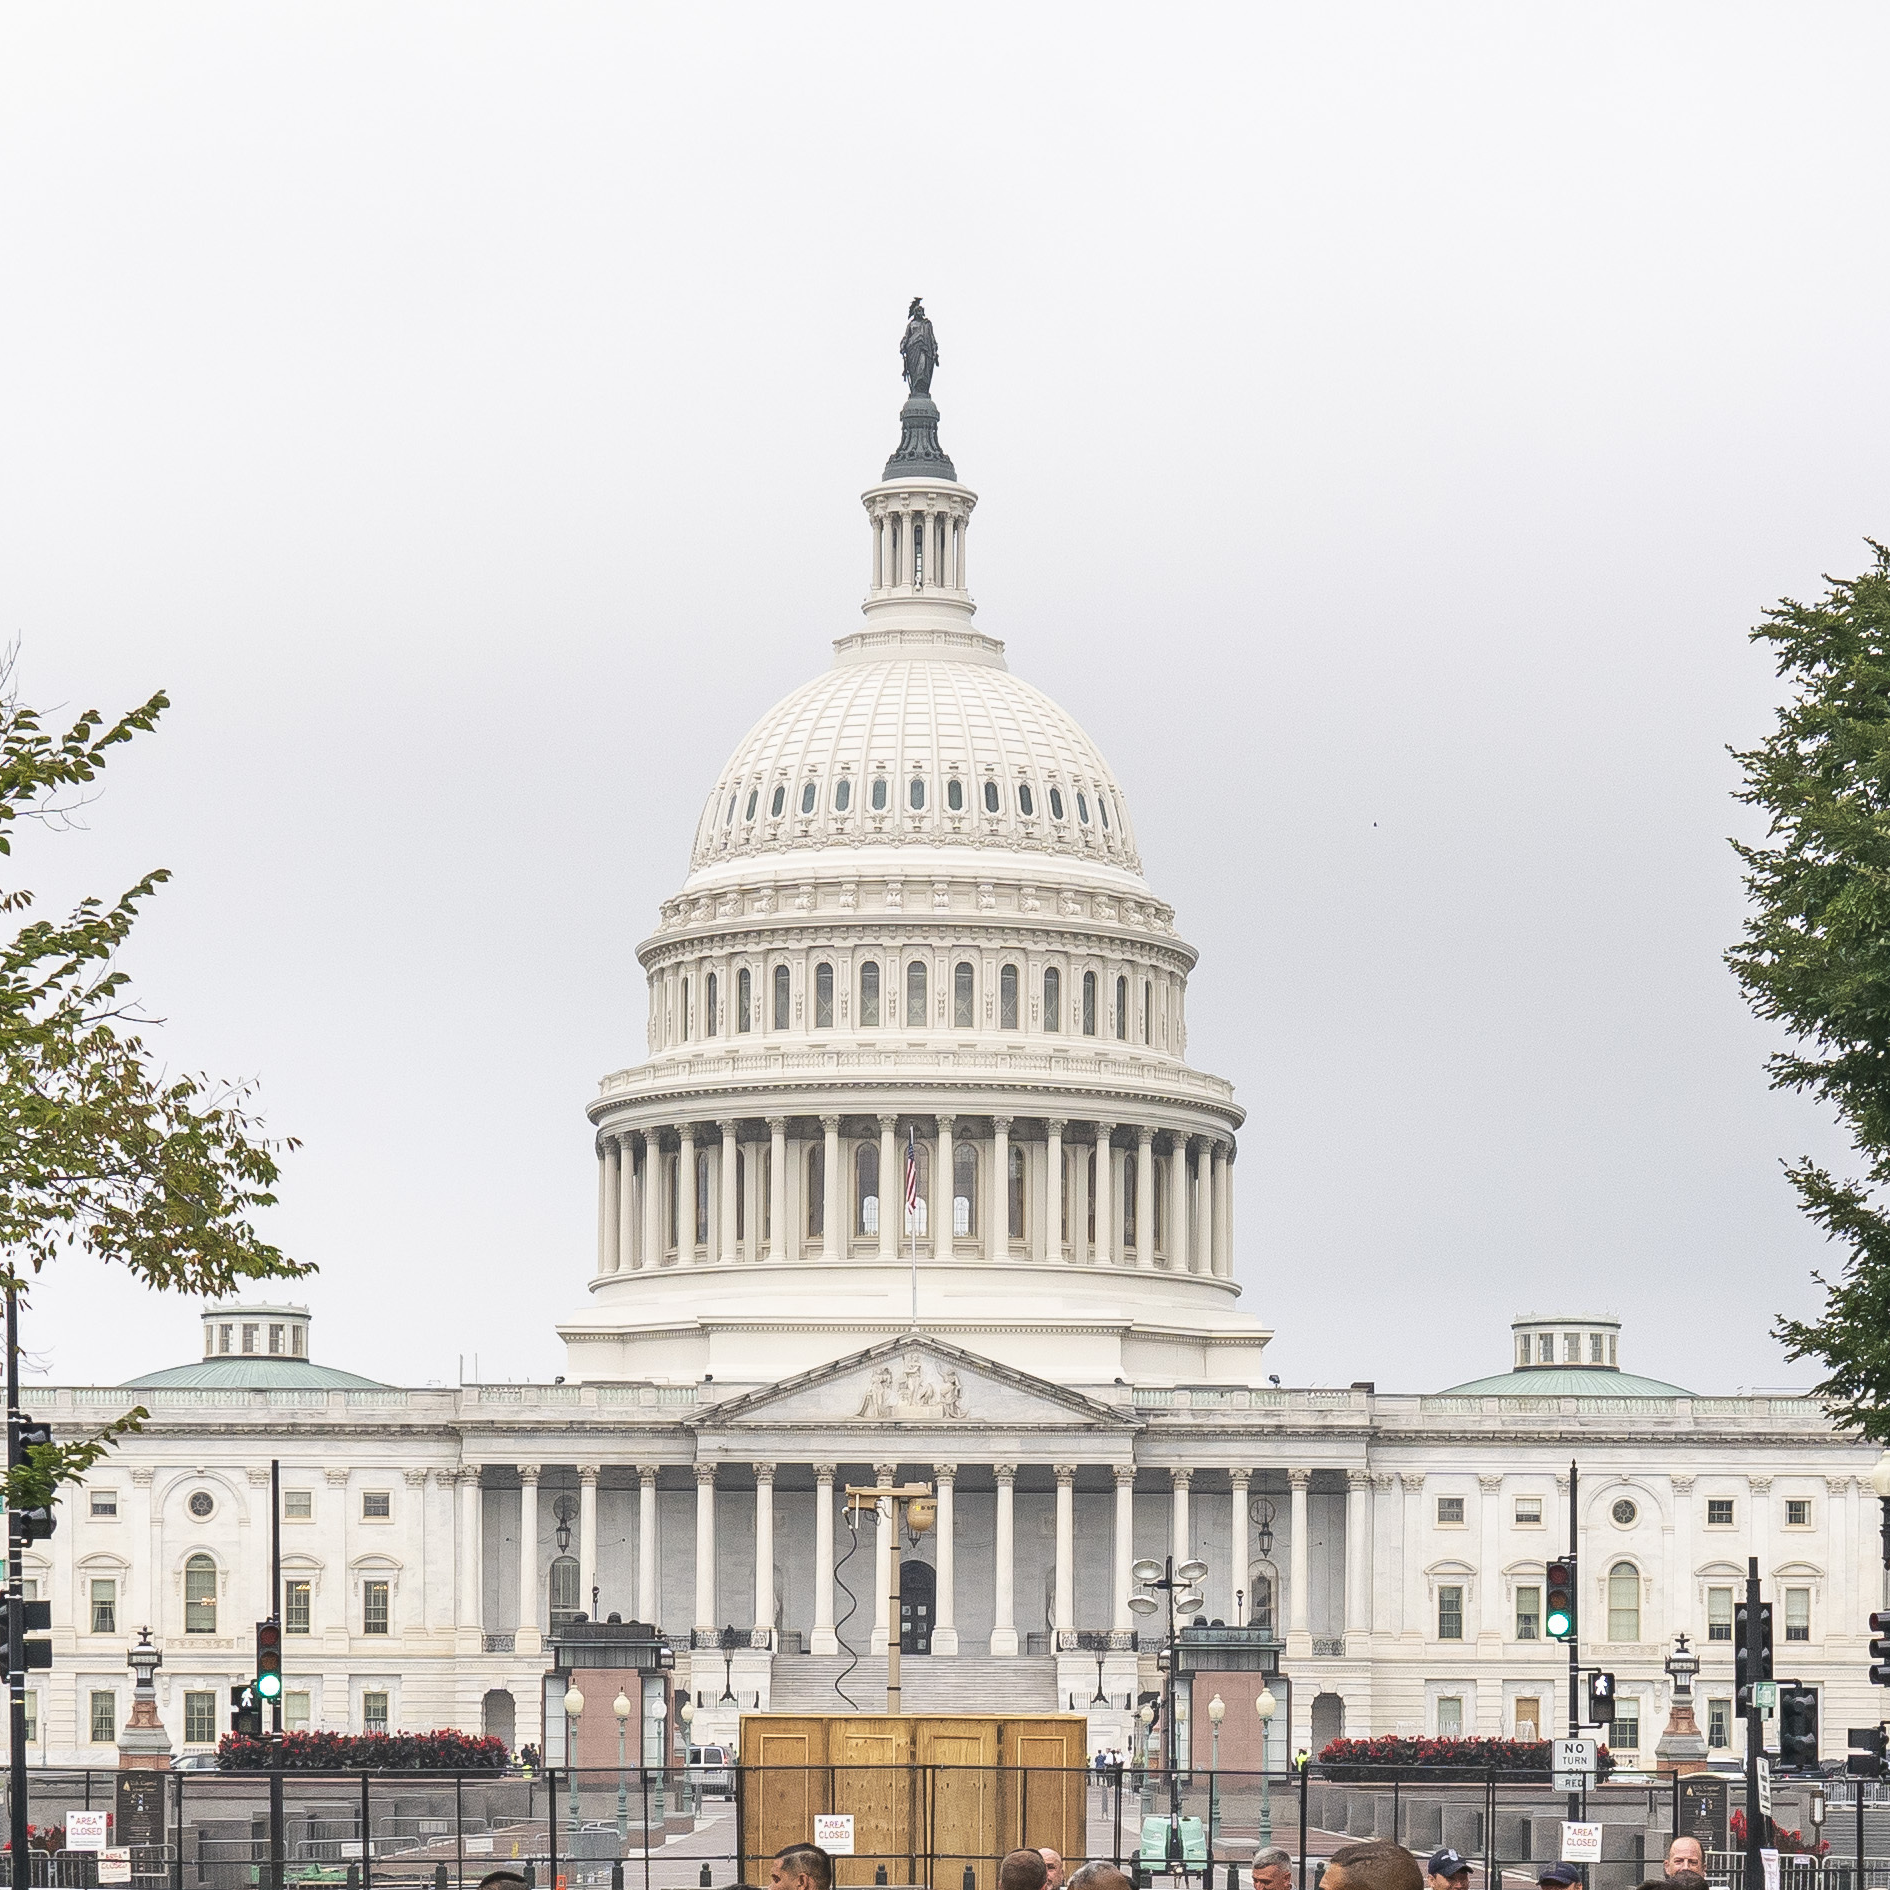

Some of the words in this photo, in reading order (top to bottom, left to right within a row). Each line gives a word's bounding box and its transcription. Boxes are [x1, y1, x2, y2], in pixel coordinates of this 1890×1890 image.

[1564, 1743, 1585, 1754] NO
[1562, 1756, 1588, 1765] TURN
[75, 1817, 98, 1826] AREA
[823, 1821, 846, 1829] AREA
[70, 1827, 103, 1836] CLOSED
[818, 1830, 851, 1839] CLOSED
[1571, 1828, 1593, 1837] AREA
[1566, 1837, 1598, 1847] CLOSED
